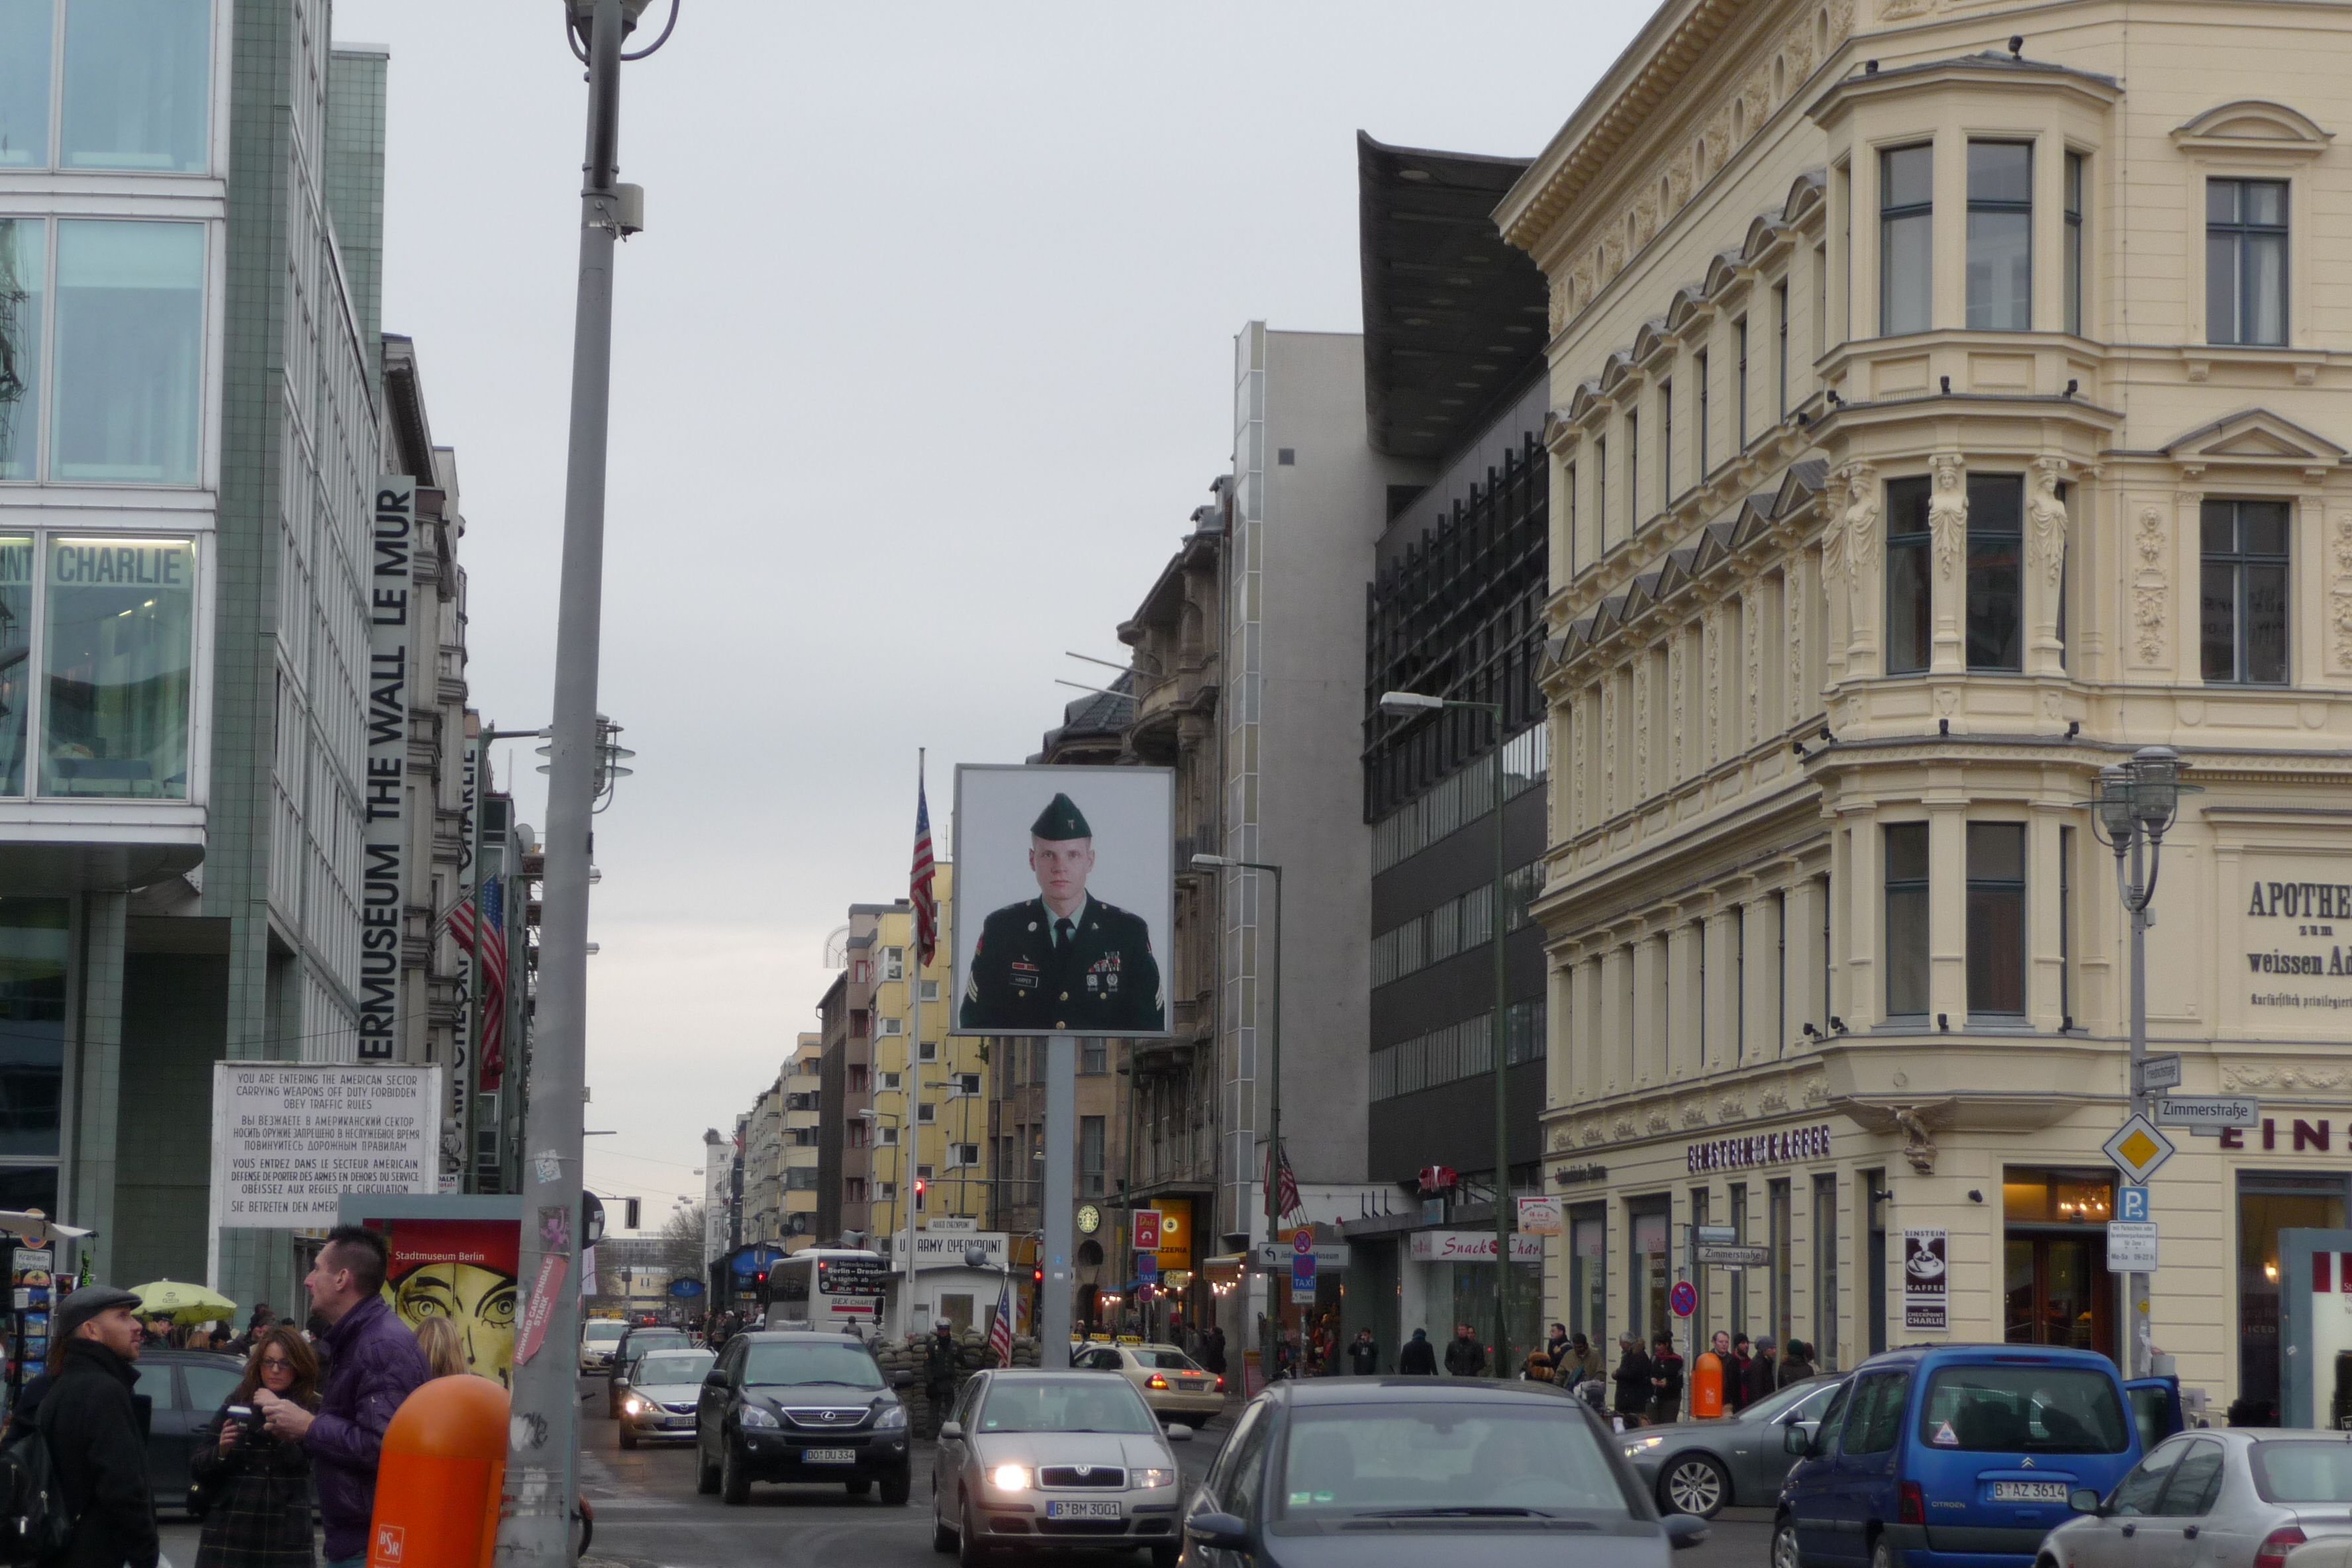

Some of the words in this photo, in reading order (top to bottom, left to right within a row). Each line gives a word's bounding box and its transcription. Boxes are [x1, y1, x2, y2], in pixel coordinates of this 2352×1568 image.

[375, 489, 410, 576] MUR
[57, 546, 181, 584] CHARLIE
[373, 589, 407, 625] LE
[369, 645, 405, 746] WALL
[366, 758, 401, 824] THE
[2248, 881, 2352, 918] APOTHE
[2299, 925, 2333, 936] zum
[2247, 948, 2324, 975] weissen
[238, 1073, 254, 1083] YOU
[259, 1073, 275, 1083] ARE
[279, 1074, 318, 1084] ENTERING
[322, 1074, 335, 1084] THE
[340, 1075, 381, 1085] AMERICAN
[387, 1075, 417, 1085] SECTOR
[236, 1086, 279, 1096] CARRYING
[283, 1087, 323, 1097] WEAPONS
[327, 1087, 342, 1097] OFF
[347, 1087, 368, 1097] DUTY
[371, 1087, 416, 1097] FORBIDDEN
[284, 1099, 305, 1108] OBEY
[310, 1099, 343, 1109] TRAFFIC
[347, 1099, 372, 1109] RULES
[2163, 1101, 2247, 1119] Zimmerstraße
[242, 1115, 254, 1126] ВЫ
[306, 1116, 311, 1126] В
[315, 1115, 381, 1126] АМЕРИКАНСКИЙ
[385, 1117, 414, 1126] СЕКТОР
[234, 1128, 260, 1138] НОСИТЬ
[262, 1128, 291, 1138] ОРУЖИЕ
[338, 1128, 342, 1138] В
[345, 1128, 395, 1139] НЕСЛУЖЕБНОЕ
[397, 1129, 420, 1139] ВРЕМЯ
[307, 1141, 357, 1151] ДОРОЖНЫМ
[362, 1141, 407, 1152] ПРАВИЛАМ
[1688, 1136, 1755, 1173] EINSTEIN
[1768, 1124, 1830, 1161] KAFFEE
[233, 1159, 255, 1168] VOUS
[260, 1159, 289, 1168] ENTREZ
[295, 1159, 317, 1168] DANS
[321, 1159, 328, 1168] LE
[334, 1159, 368, 1169] SECTEUR
[373, 1159, 418, 1169] AMERICAIN
[232, 1171, 260, 1181] DEFENSE
[263, 1171, 273, 1181] DE
[273, 1171, 297, 1181] PORTER
[299, 1171, 312, 1181] DES
[315, 1172, 336, 1181] ARMES
[339, 1172, 348, 1181] EN
[351, 1172, 377, 1181] DEHORS
[380, 1172, 389, 1181] DU
[391, 1172, 419, 1181] SERVICE
[242, 1182, 283, 1194] OBÉISSEZ
[288, 1185, 304, 1194] AUX
[309, 1185, 338, 1194] REGLES
[342, 1185, 353, 1193] DE
[357, 1185, 408, 1194] CIRCULATION
[232, 1200, 244, 1212] SIE
[249, 1201, 288, 1212] BETRETEN
[293, 1201, 308, 1212] DEN
[917, 1239, 943, 1252] ARMY
[1442, 1236, 1487, 1255] Snack
[395, 1251, 456, 1260] Stadtmuseum
[459, 1251, 485, 1261] Berlin
[1704, 1248, 1761, 1261] Zimmerstraße
[1295, 1278, 1313, 1287] TAXI
[516, 1319, 532, 1360] HOWARD
[528, 1257, 554, 1320] CARPENDALE
[534, 1295, 550, 1329] STARK
[824, 1451, 837, 1460] DU
[838, 1451, 854, 1460] 334
[1995, 1483, 2003, 1496] B
[2013, 1483, 2030, 1497] AZ
[2033, 1483, 2065, 1498] 3614
[1056, 1503, 1063, 1514] B
[1071, 1503, 1087, 1515] BM
[1089, 1504, 1118, 1515] 3001
